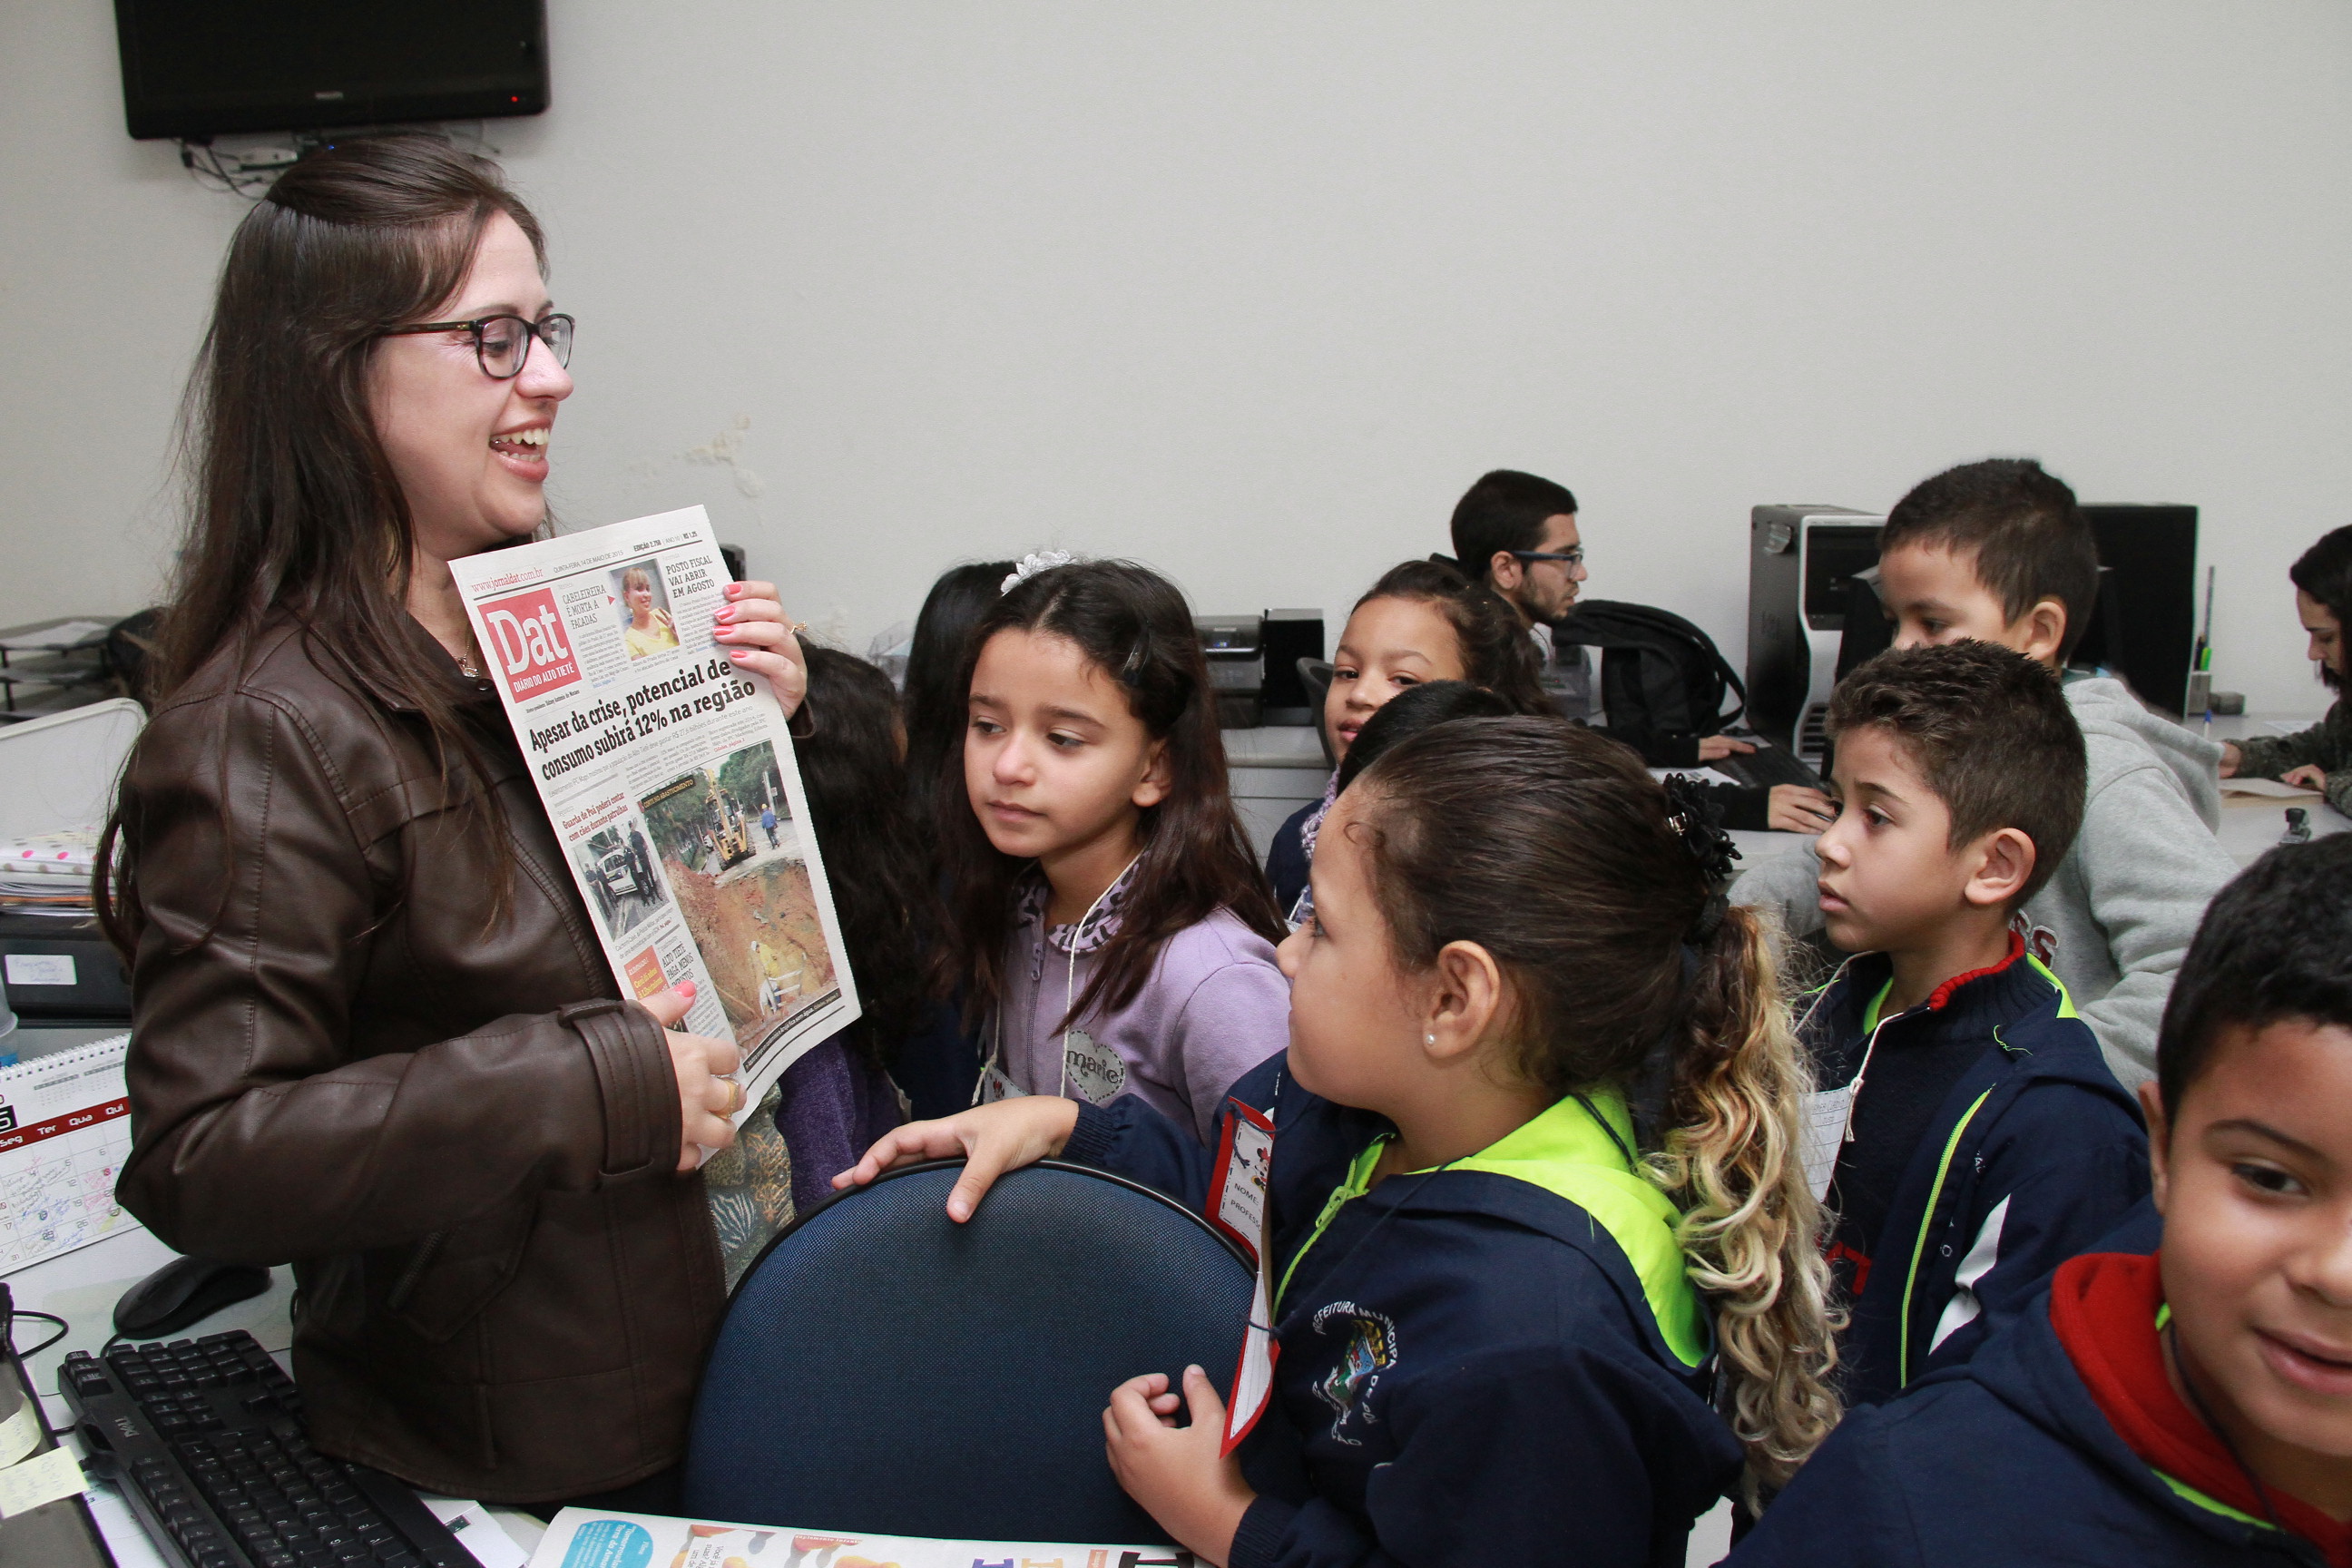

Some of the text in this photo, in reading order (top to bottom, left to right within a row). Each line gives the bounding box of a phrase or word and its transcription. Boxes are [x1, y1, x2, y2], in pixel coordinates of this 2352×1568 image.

[593, 554, 604, 564] MAIO
[612, 550, 623, 559] 2015
[666, 561, 690, 574] POSTO
[690, 555, 713, 569] FISCAL
[471, 567, 544, 593] www.jornaldat.com.br
[669, 569, 708, 586] VAI ABRIR
[563, 584, 606, 604] CABELEIREIRA
[672, 579, 715, 599] EM AGOSTO
[566, 600, 600, 617] É MORTA A
[571, 613, 598, 630] FACADAS
[486, 604, 568, 675] Dat
[514, 662, 575, 693] DIÁRIO DO ALTO TIETÊ
[530, 659, 731, 753] Apesar da crise, potencial de
[707, 714, 728, 728] durante
[728, 710, 740, 718] este
[543, 744, 595, 780] consumo
[594, 719, 636, 755] subirá
[635, 710, 668, 737] 12%
[670, 703, 691, 723] na
[693, 680, 755, 713] região
[563, 815, 581, 829] Guarda
[581, 811, 588, 820] de
[586, 805, 596, 817] Poá
[596, 797, 612, 814] poderá
[612, 792, 624, 804] contar
[569, 804, 628, 842] com cães durante patrulhas
[662, 953, 674, 967] ALTO
[672, 941, 686, 958] TIETÊ
[666, 953, 693, 980] PAGA MENOS
[1067, 1051, 1120, 1083] marie
[105, 1103, 124, 1115] Qui
[69, 1114, 93, 1125] Qua
[37, 1125, 56, 1134] Ter
[0, 1135, 24, 1147] Seg
[1234, 1183, 1259, 1206] NOME:
[76, 1220, 89, 1229] 26
[1312, 1300, 1357, 1336] PREFEITURA
[691, 1550, 700, 1559] um
[702, 1544, 712, 1559] suas?
[715, 1545, 724, 1560] Você
